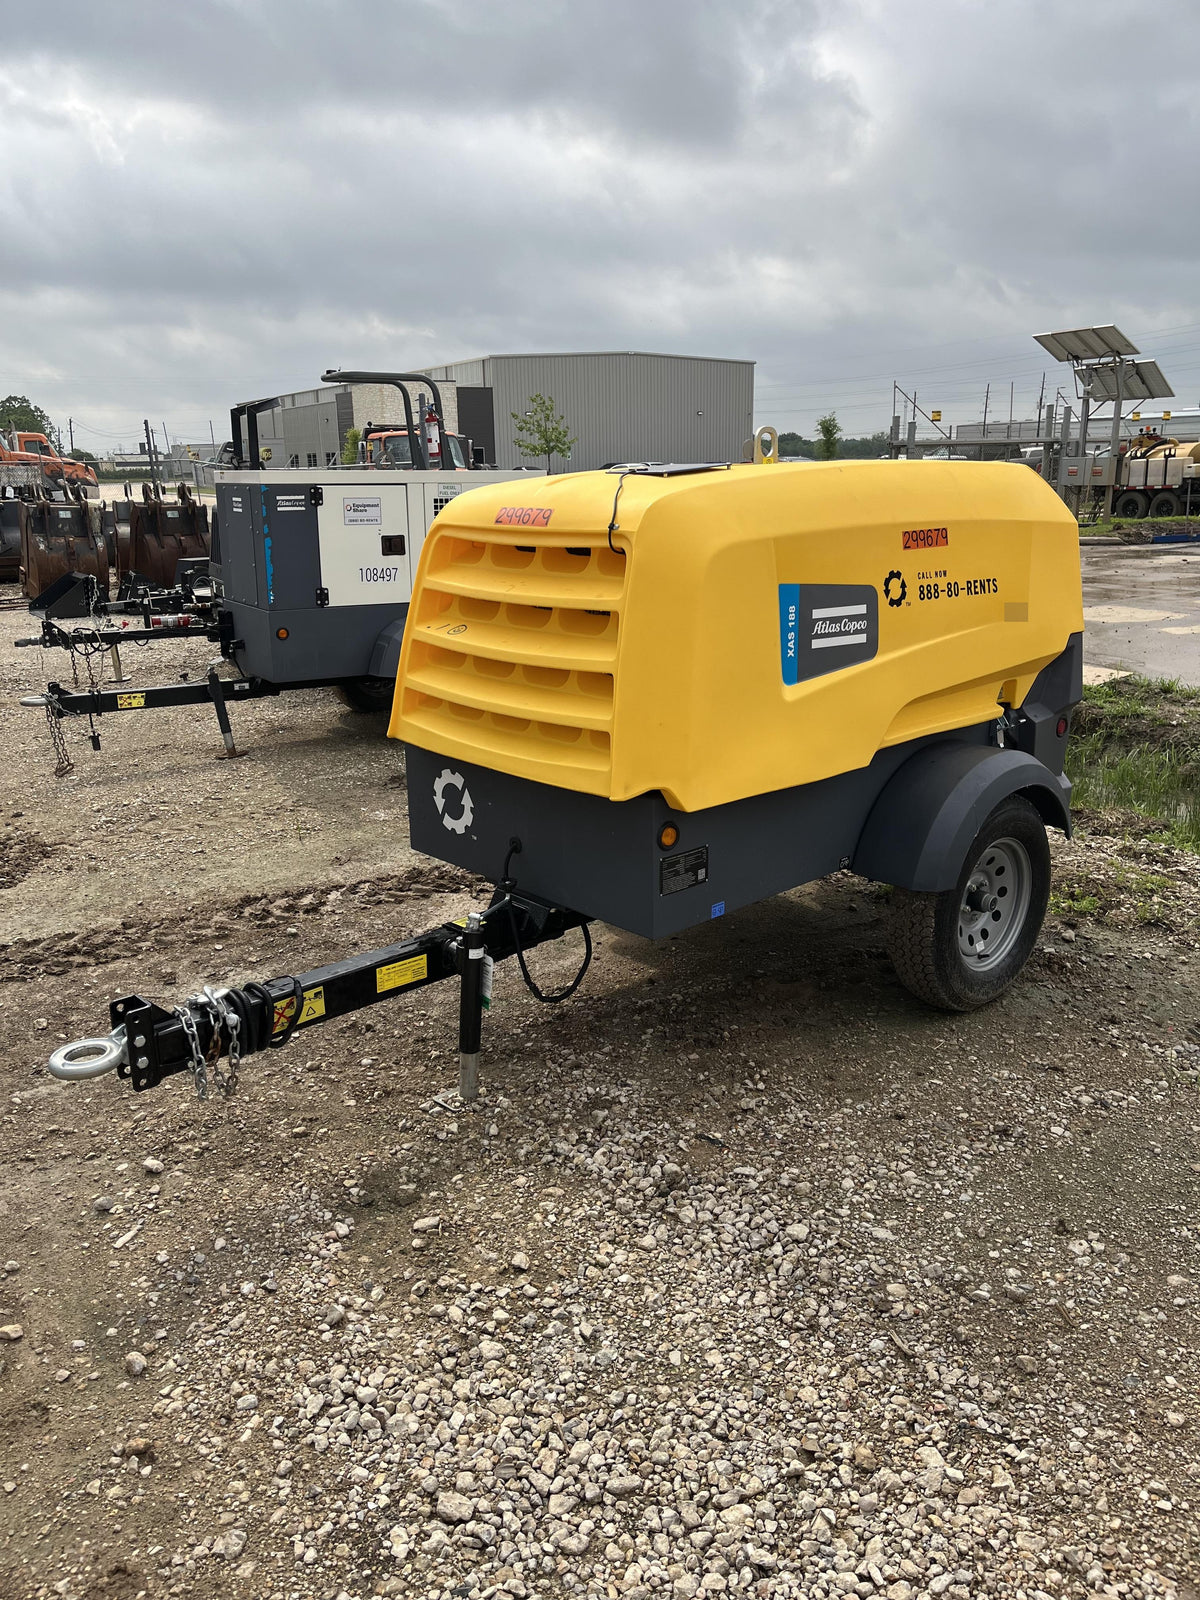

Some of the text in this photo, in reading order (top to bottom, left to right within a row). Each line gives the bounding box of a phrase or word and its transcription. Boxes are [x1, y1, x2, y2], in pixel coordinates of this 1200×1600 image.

[495, 507, 552, 526] 299679
[903, 528, 949, 549] 299679
[359, 567, 398, 582] 108497
[918, 570, 947, 580] CALL NOW
[919, 578, 998, 601] 888-80-RENTS
[788, 605, 796, 628] 188
[812, 618, 868, 635] Atlas Copco
